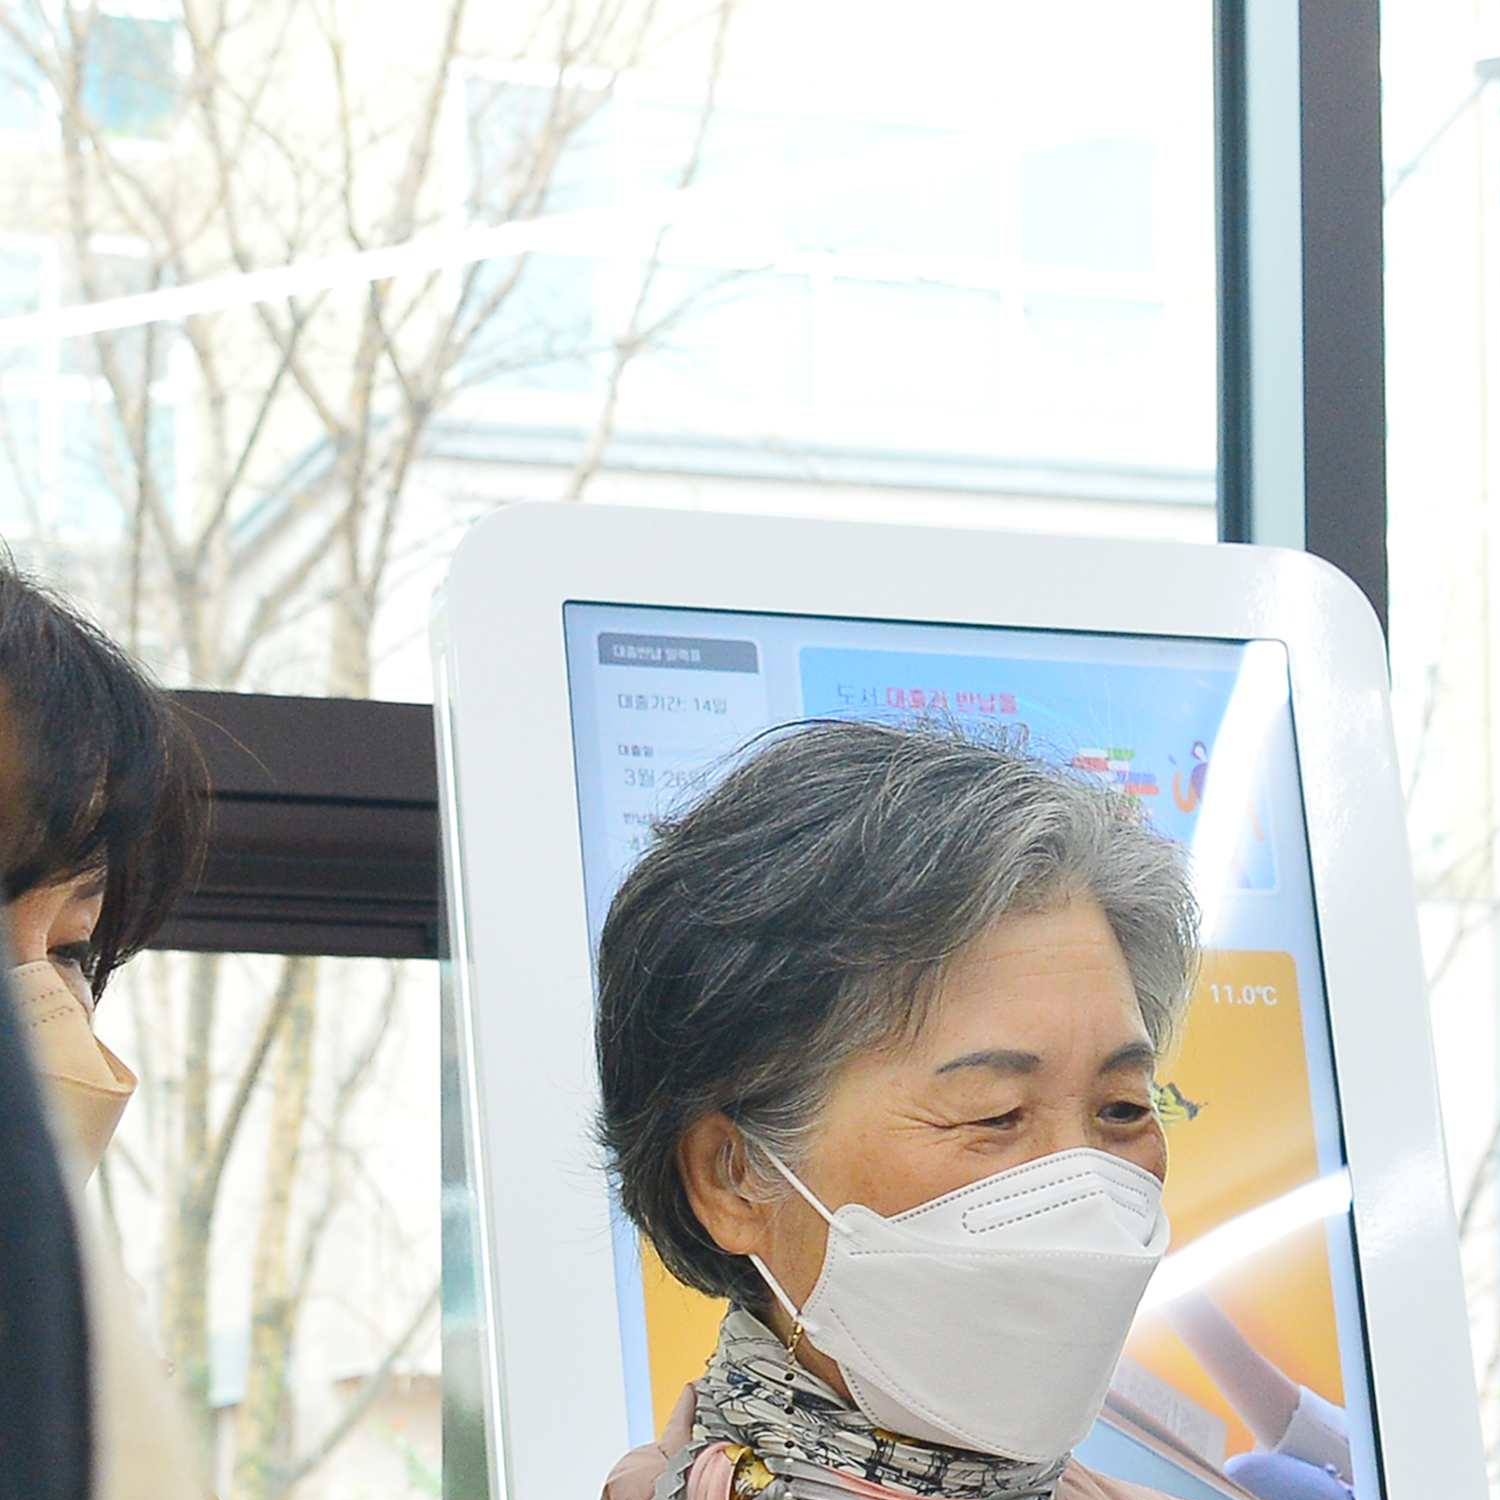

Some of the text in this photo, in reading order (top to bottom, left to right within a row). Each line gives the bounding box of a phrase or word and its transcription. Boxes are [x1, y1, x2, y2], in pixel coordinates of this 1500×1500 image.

[838, 684, 884, 706] 도서
[694, 698, 727, 715] 14일
[624, 768, 655, 788] 3월
